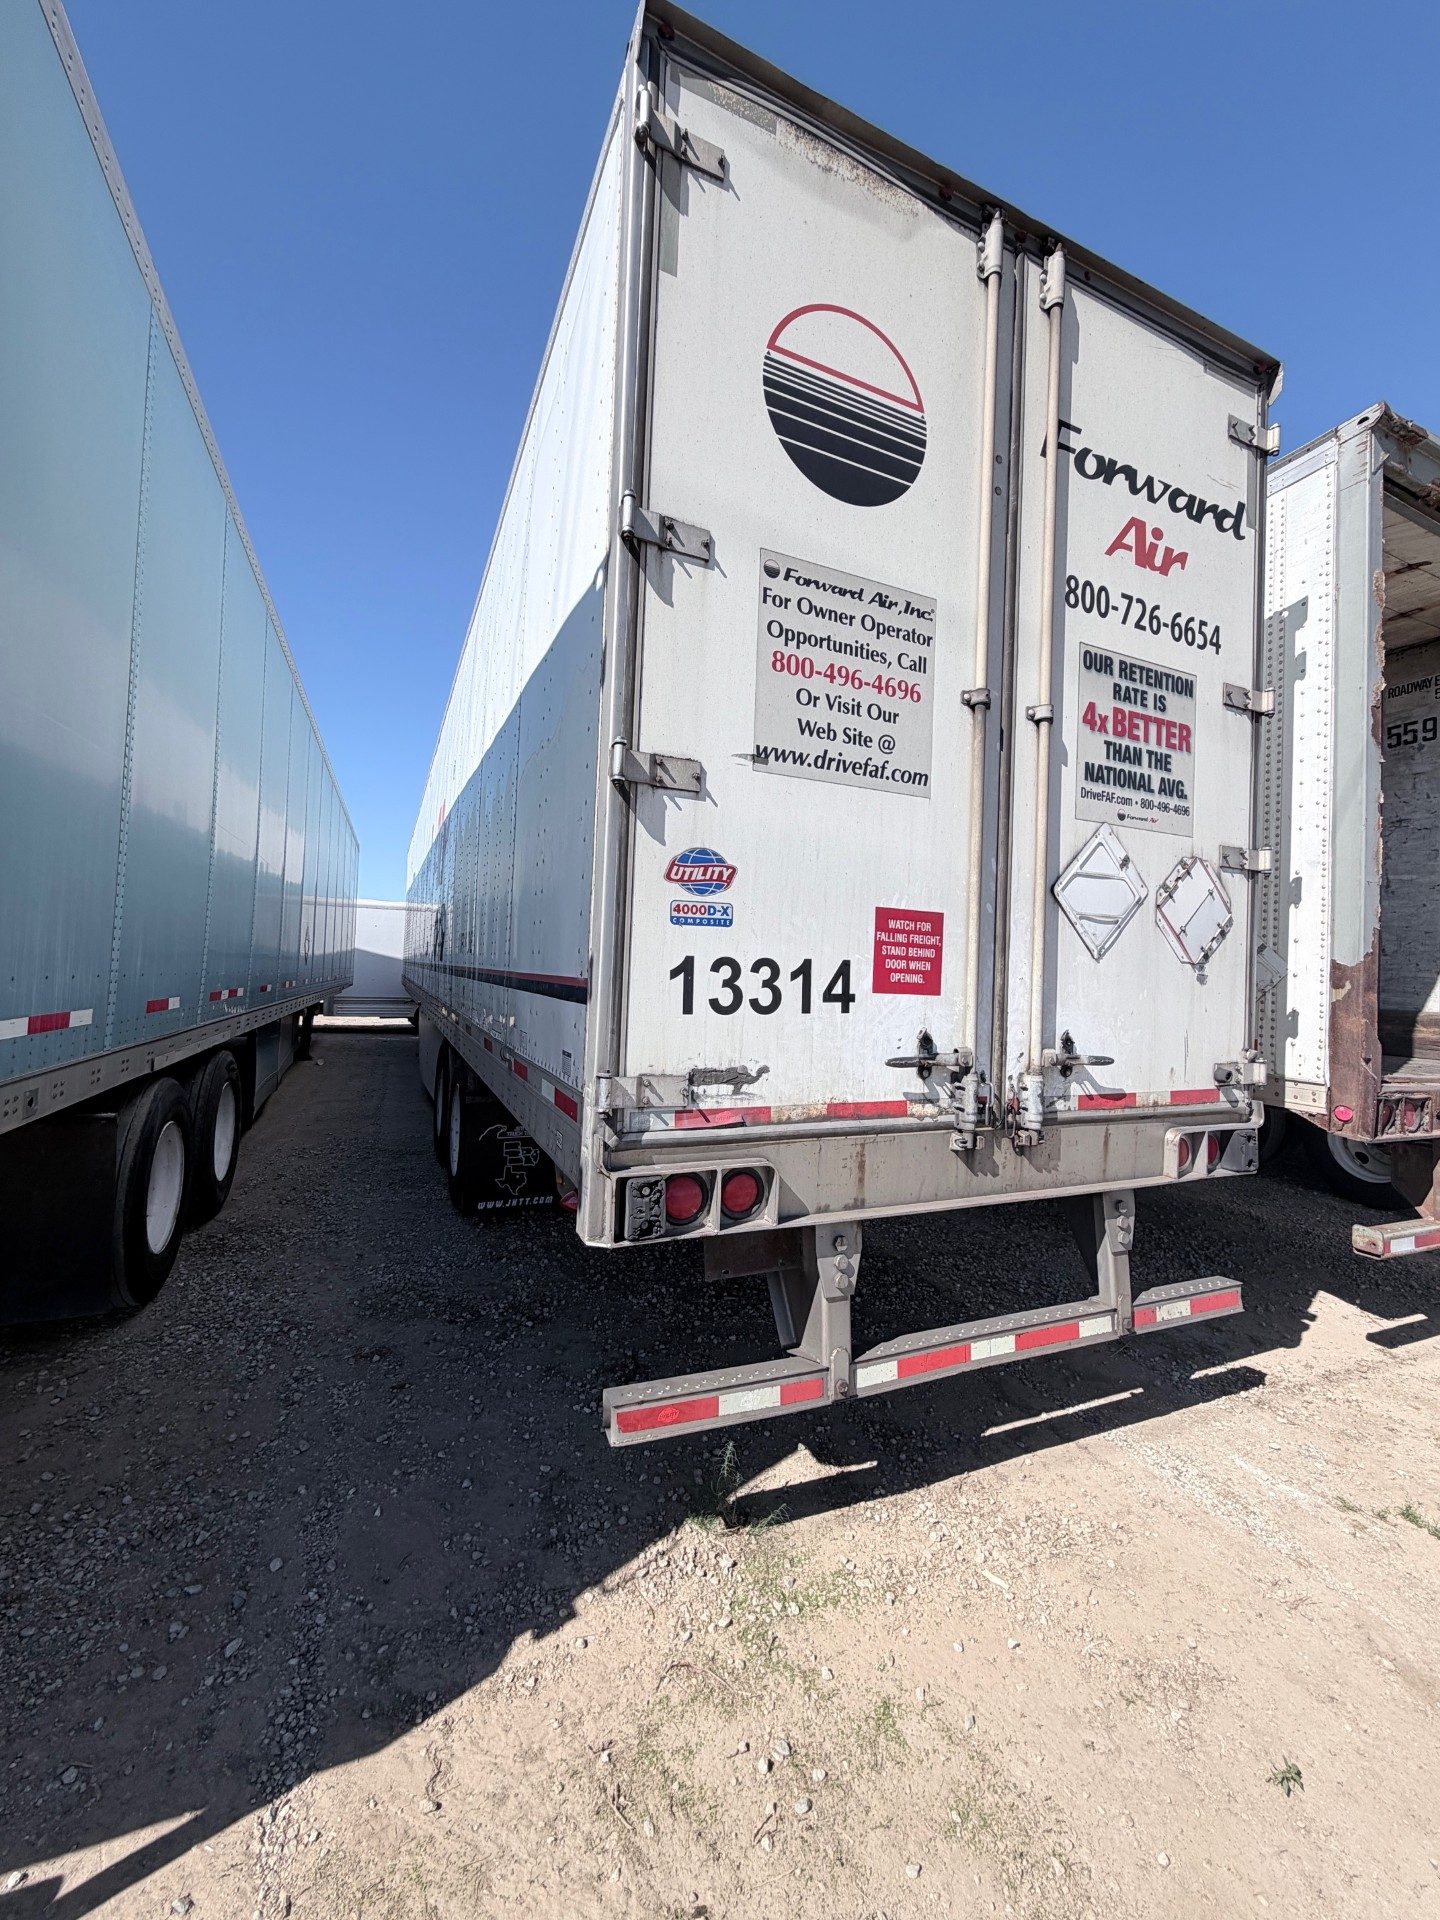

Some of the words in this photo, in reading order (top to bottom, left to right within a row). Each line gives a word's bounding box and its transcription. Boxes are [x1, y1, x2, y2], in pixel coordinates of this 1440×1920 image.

[1040, 418, 1246, 541] Forward
[1104, 516, 1189, 577] Air
[783, 567, 864, 602] Forward
[762, 586, 792, 610] For
[797, 596, 856, 627] Owner
[861, 614, 933, 648] Operator
[1064, 574, 1221, 656] 800-726-6654
[766, 619, 893, 669] Opportunities,
[897, 652, 927, 674] Call
[771, 650, 922, 703] 800-496-4696
[1083, 649, 1114, 677] OUR
[1118, 659, 1194, 698] RETENTION
[1387, 676, 1434, 699] ROADWAY
[795, 687, 821, 709] Or
[824, 693, 862, 718] Visit
[867, 703, 900, 724] Our
[1112, 682, 1148, 708] RATE
[1153, 693, 1167, 713] IS
[797, 717, 837, 742] Web
[842, 727, 873, 748] Site
[878, 734, 896, 755] @
[1082, 701, 1109, 735] 4x
[1112, 706, 1192, 753] BETTER
[1386, 716, 1438, 750] 559
[755, 744, 929, 787] www.drivefaf.com
[1103, 739, 1143, 767] THAN
[1146, 749, 1172, 773] THE
[1084, 761, 1155, 794] NATIONAL
[1158, 776, 1188, 800] AVG.
[1080, 786, 1133, 808] DriveFAF.com
[1140, 798, 1191, 817] 800-496-4696
[670, 865, 733, 881] UTILITY
[672, 917, 730, 926] COMPOSITE
[673, 903, 730, 917] 4000D-X
[888, 919, 915, 931] WATCH
[916, 921, 932, 932] FOR
[876, 931, 908, 943] FALLING
[909, 934, 942, 947] FREIGHT,
[881, 945, 907, 956] STAND
[908, 947, 936, 958] BEHIND
[885, 958, 907, 970] DOOR
[908, 960, 931, 971] WHEN
[890, 972, 925, 984] OPENING.
[669, 955, 856, 1016] 13314
